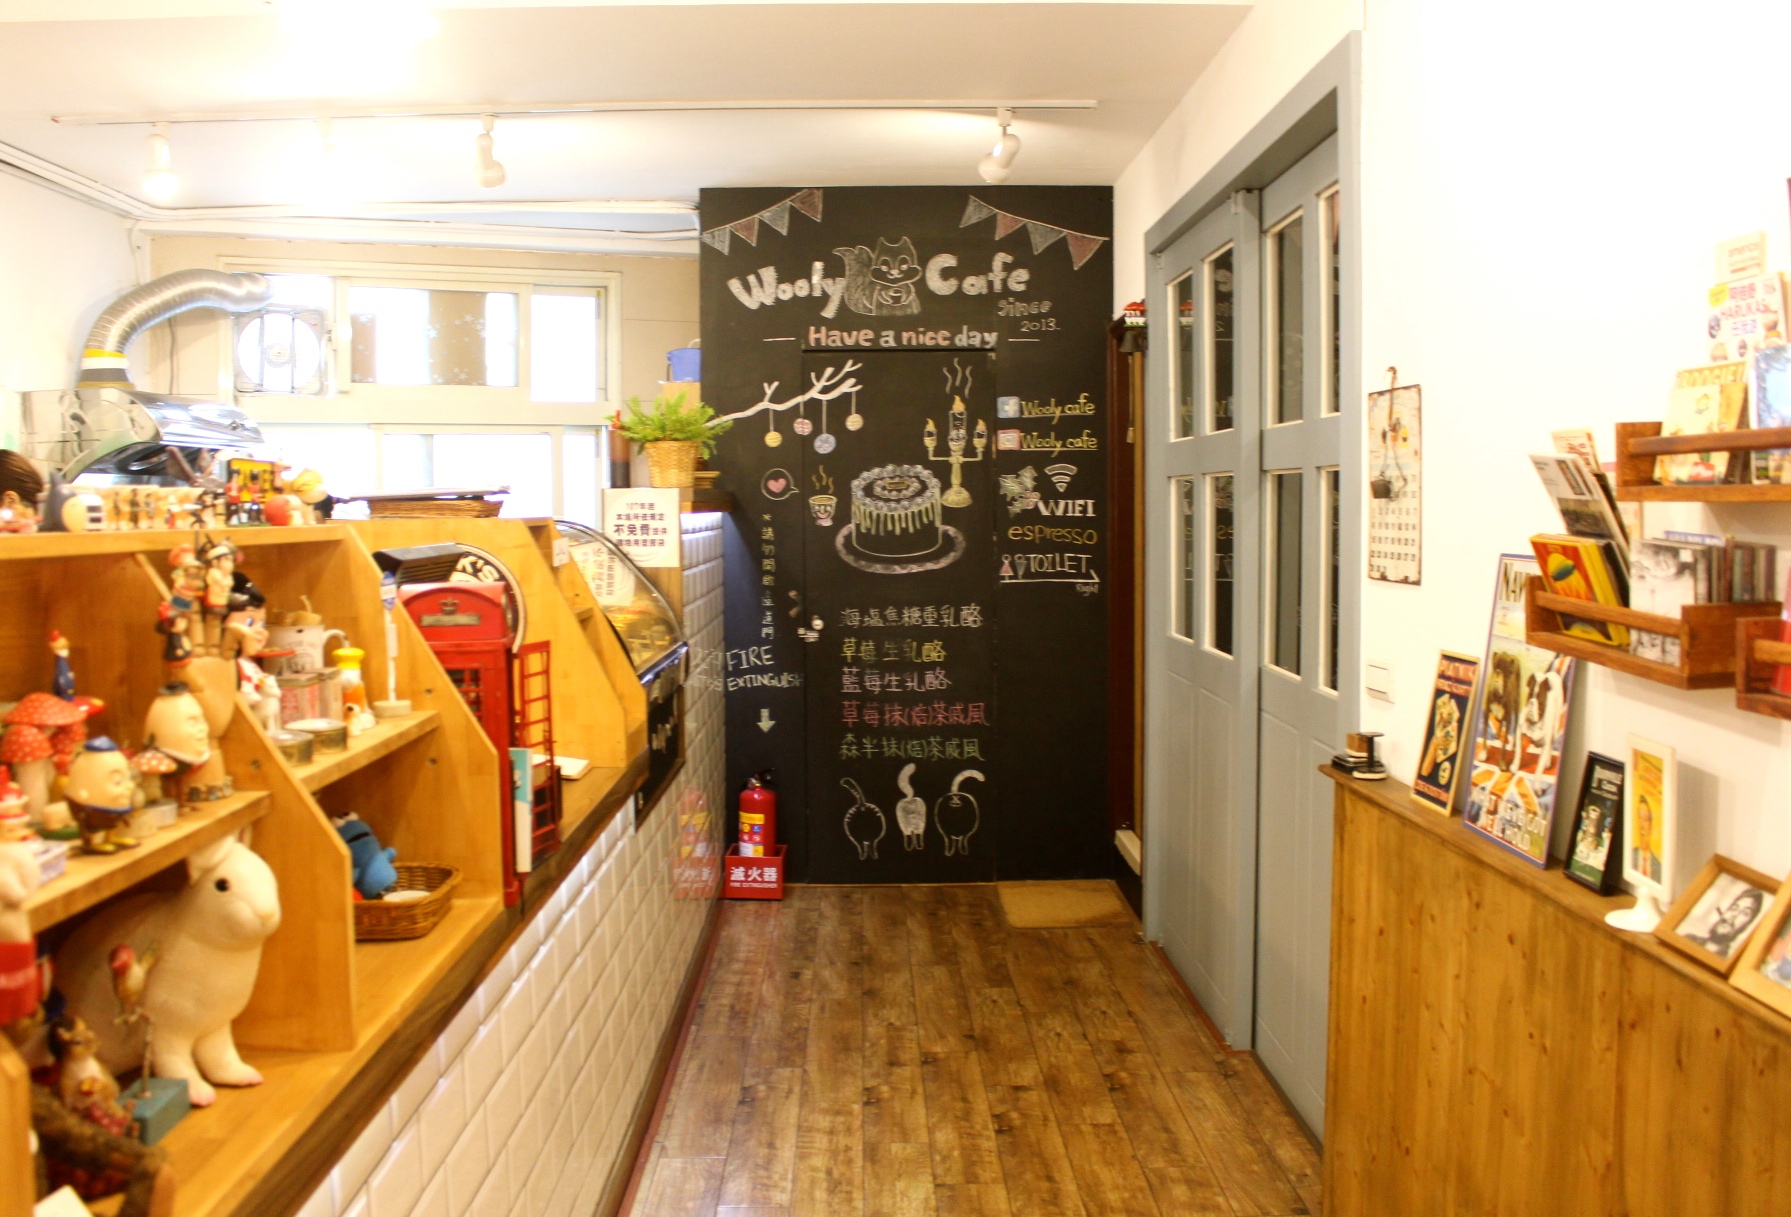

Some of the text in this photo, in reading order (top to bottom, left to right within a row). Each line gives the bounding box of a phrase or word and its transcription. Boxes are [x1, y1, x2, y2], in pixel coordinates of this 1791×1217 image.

[726, 252, 1031, 319] Wooly Cafe
[809, 325, 998, 348] Have a nice day
[1021, 398, 1062, 424] Wooly
[1064, 393, 1096, 414] cafe
[1021, 430, 1098, 457] Wooly cafe
[1037, 500, 1097, 516] WIFI
[1008, 525, 1098, 544] espresso
[1025, 553, 1093, 573] TOILET
[725, 645, 775, 671] FIRE
[730, 866, 778, 882] 滅火器
